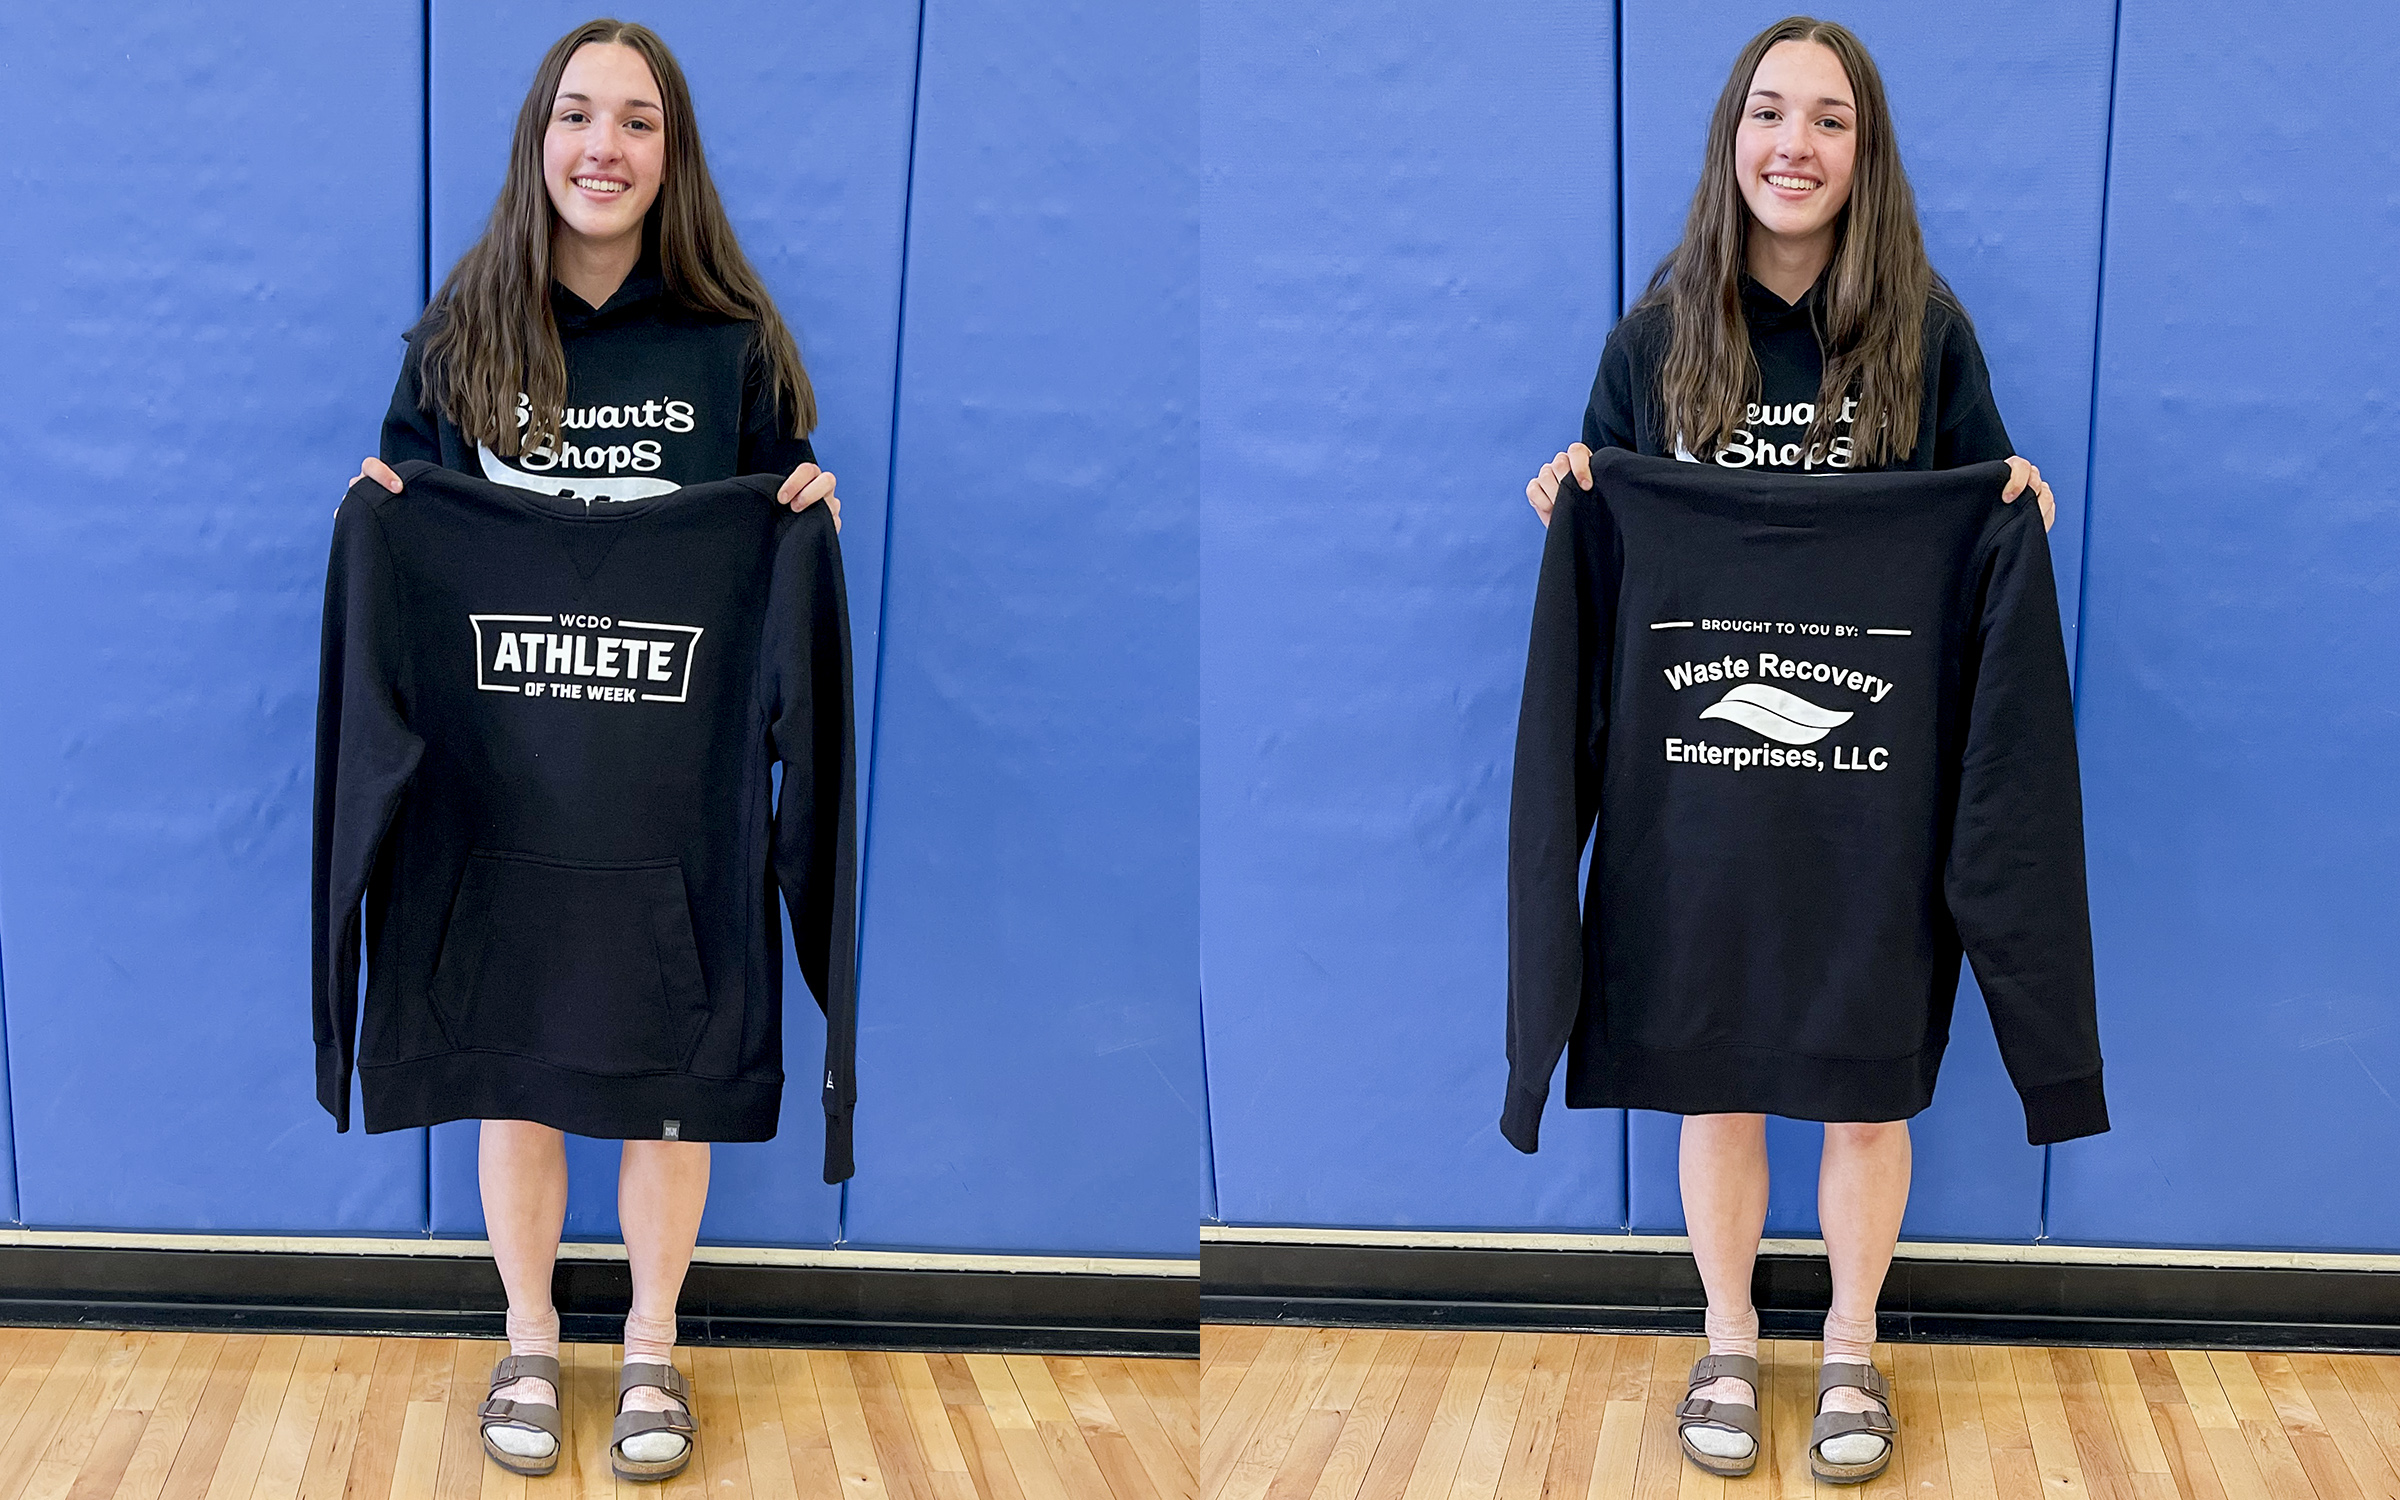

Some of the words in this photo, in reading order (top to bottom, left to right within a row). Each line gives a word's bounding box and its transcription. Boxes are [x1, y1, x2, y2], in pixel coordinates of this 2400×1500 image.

[559, 613, 612, 630] WCDO
[1701, 618, 1772, 634] BROUGHT
[1775, 622, 1795, 635] TO
[1799, 623, 1830, 636] YOU
[1834, 625, 1859, 637] BY:
[493, 631, 675, 682] ATHLETE
[1663, 655, 1750, 691] Waste
[1759, 652, 1894, 703] Recovery
[524, 681, 546, 697] OF
[549, 682, 583, 700] THE
[586, 685, 637, 703] WEEK
[1665, 737, 1824, 772] Enterprises,
[1833, 745, 1889, 771] LLC
